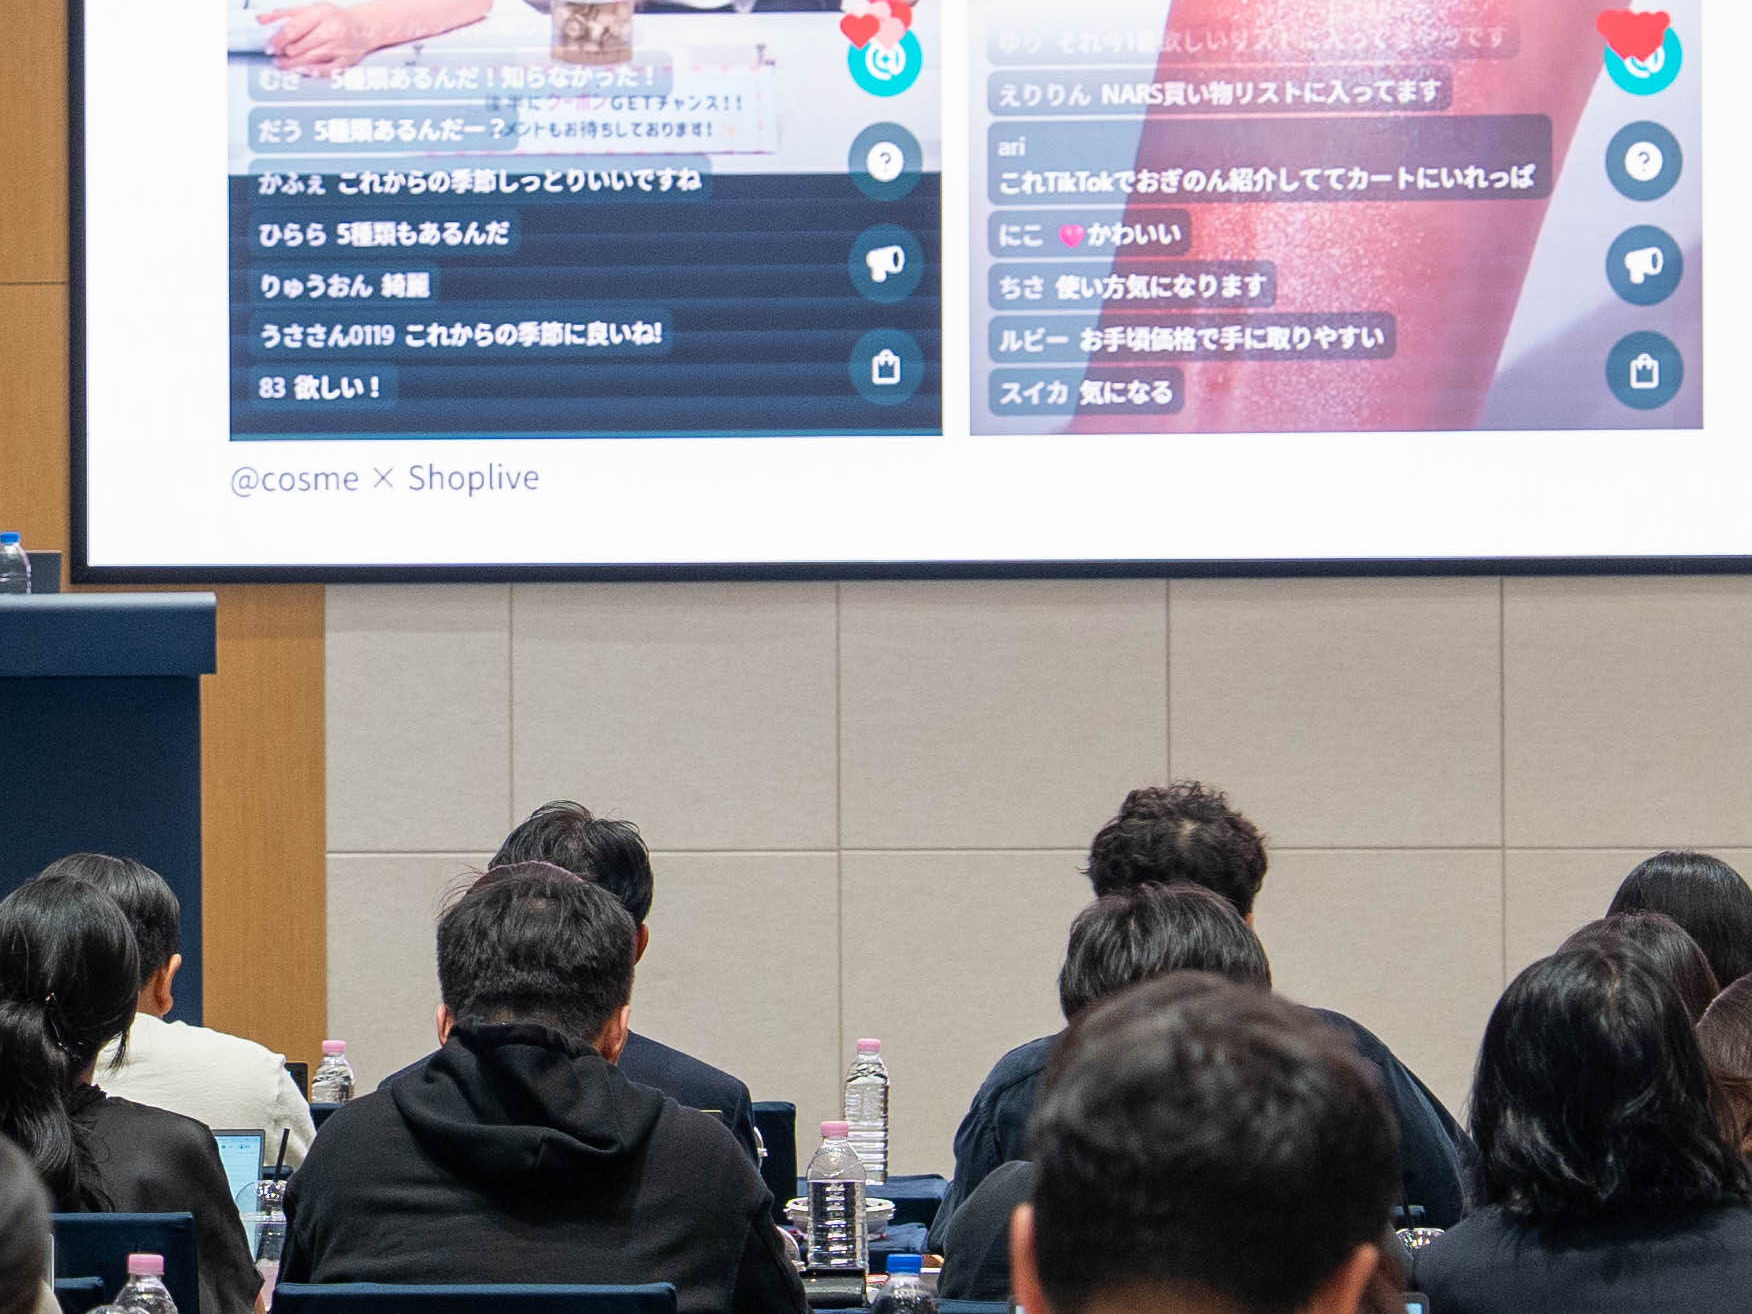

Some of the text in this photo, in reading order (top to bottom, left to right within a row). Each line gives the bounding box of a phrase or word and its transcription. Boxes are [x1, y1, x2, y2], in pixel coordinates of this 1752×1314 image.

[999, 79, 1441, 107] えりりん NARS買い物リストに入ってます
[998, 137, 1026, 157] ari
[337, 167, 703, 195] これからの季節しっとりいいですね
[258, 222, 327, 247] ひらら
[998, 222, 1182, 248] にこ かわいい
[260, 273, 374, 299] りゅうおん
[999, 272, 1267, 301] ちさ 使い方気になります
[260, 323, 396, 349] うささん0119
[1079, 324, 1385, 354] お手頃価格で手に取りやすい
[258, 376, 287, 399] 83
[999, 379, 1174, 406] スイカ 気になる
[231, 466, 359, 497] @cosme
[409, 463, 540, 497] Shoplive
